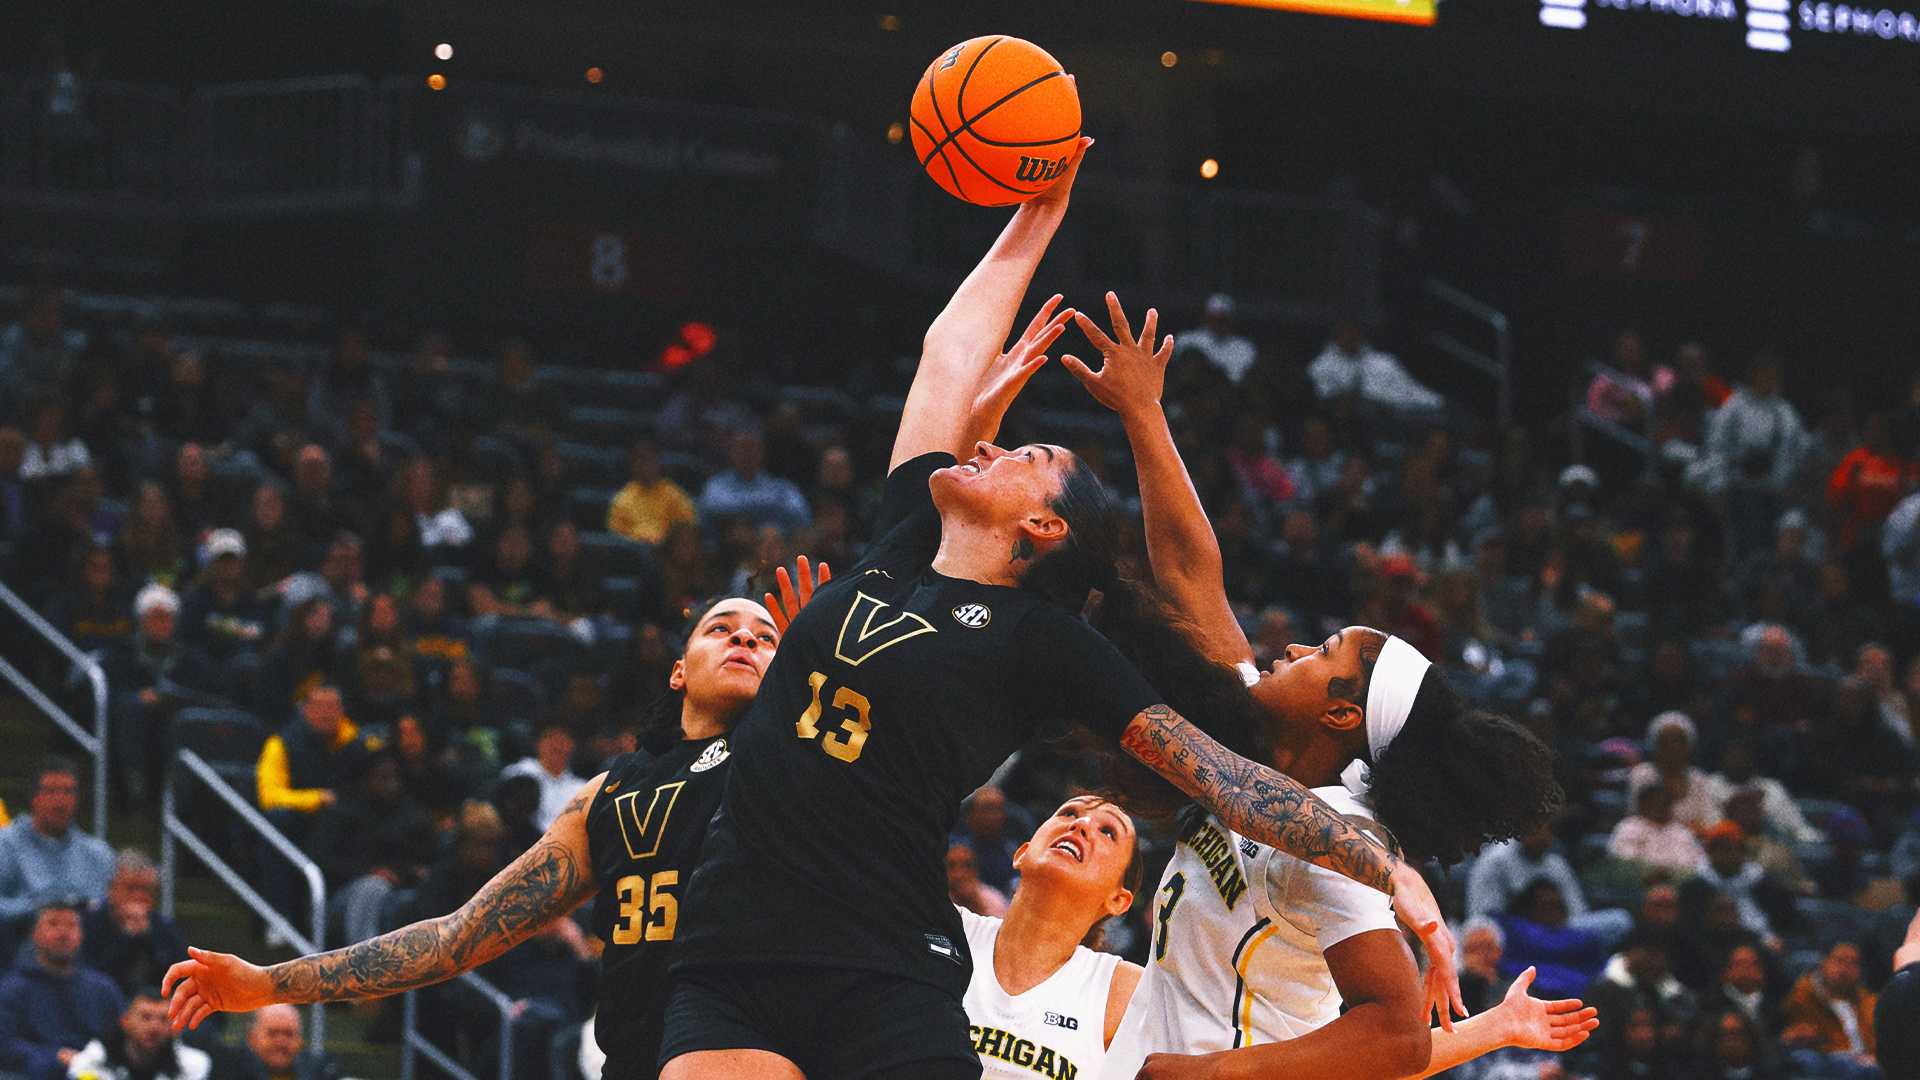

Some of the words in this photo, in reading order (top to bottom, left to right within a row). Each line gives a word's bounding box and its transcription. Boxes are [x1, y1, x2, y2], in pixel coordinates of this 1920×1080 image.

[1798, 0, 1920, 42] SEPHOR
[592, 235, 626, 287] 8
[1625, 222, 1645, 264] 7
[835, 591, 938, 666] V
[954, 603, 989, 627] SEC
[796, 671, 871, 763] 13
[614, 780, 687, 859] V
[612, 869, 679, 944] 35
